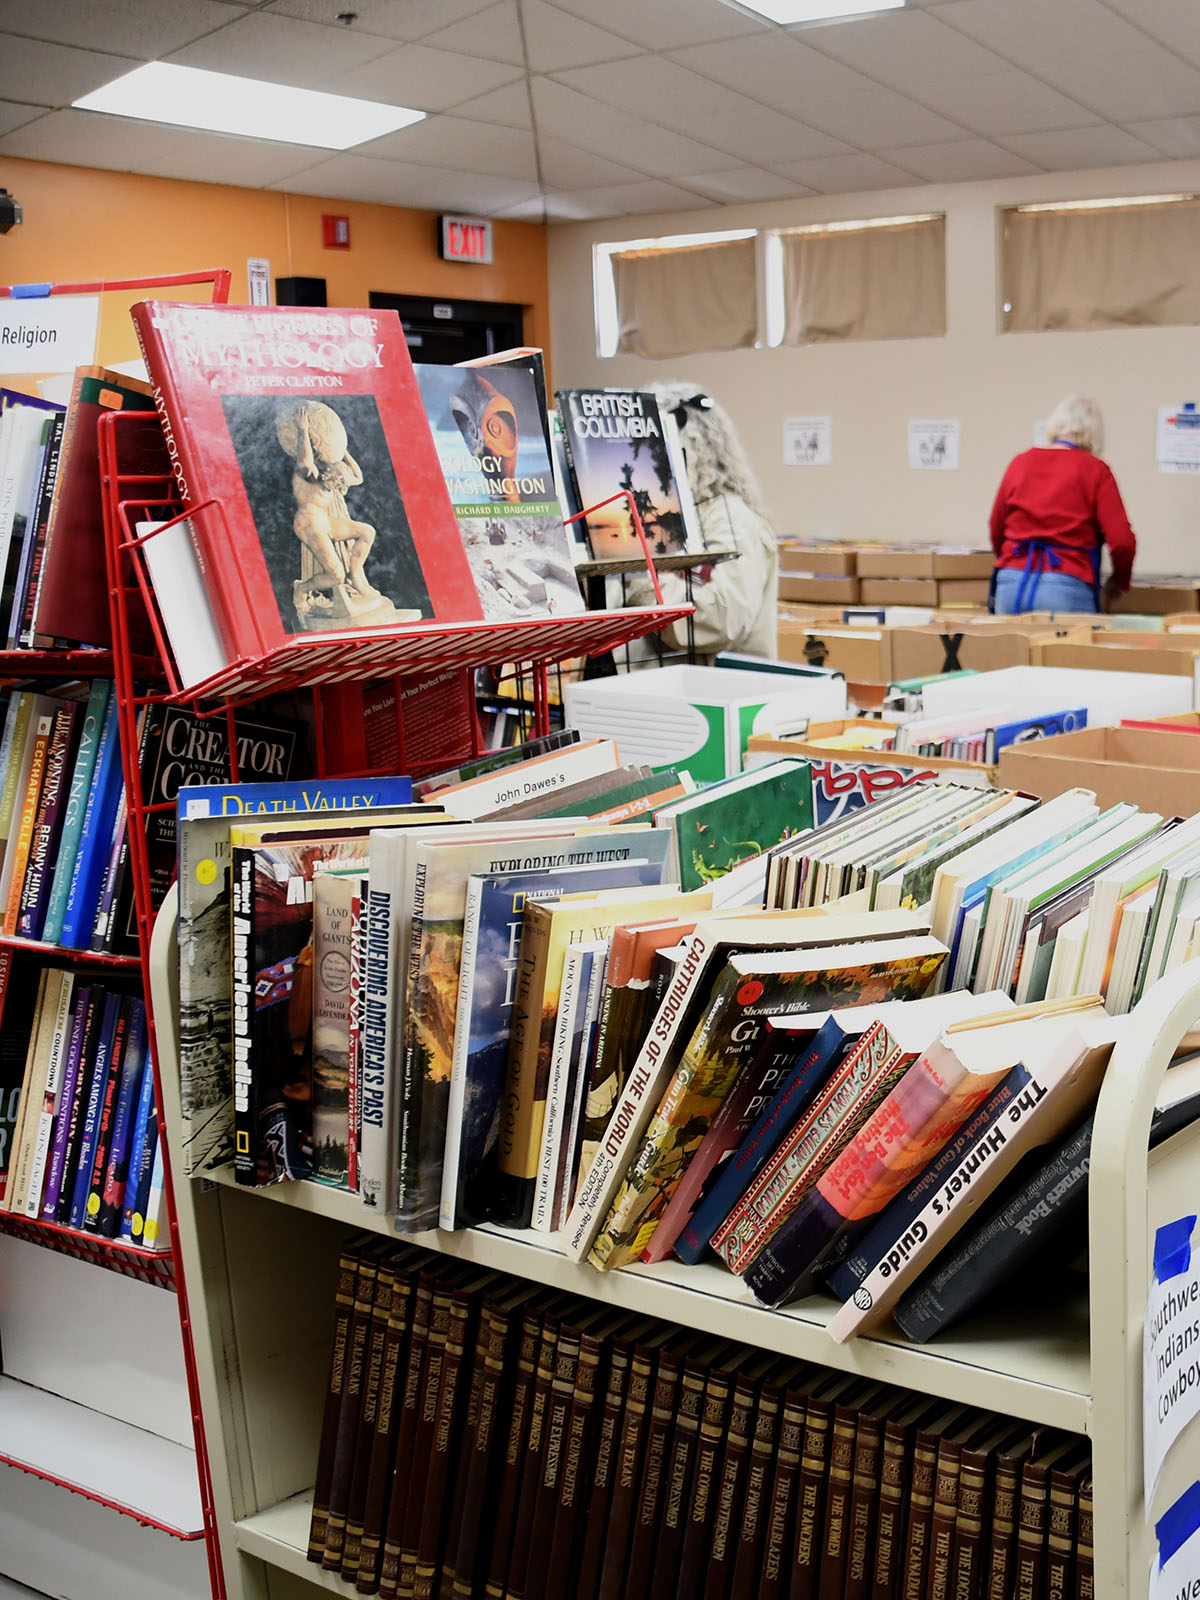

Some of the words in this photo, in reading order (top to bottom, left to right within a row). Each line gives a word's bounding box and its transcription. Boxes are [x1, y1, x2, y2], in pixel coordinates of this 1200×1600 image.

[447, 222, 486, 258] EXIT
[2, 325, 57, 348] Religion
[285, 375, 343, 388] CLAYTON
[581, 395, 643, 417] BRITISH
[53, 422, 64, 443] HAL
[153, 386, 191, 501] MYTHOLOGY
[574, 415, 659, 439] COLUMBIA
[45, 451, 59, 499] LINDSEY
[456, 505, 491, 515] RICHARD
[493, 506, 502, 515] D.
[503, 504, 551, 515] DAUGHERTY
[38, 522, 47, 541] THE
[32, 547, 45, 577] FINAL
[25, 583, 39, 620] BATTLE
[406, 686, 419, 698] Your
[419, 678, 439, 692] Perfect
[193, 720, 212, 729] THE
[25, 741, 46, 806] ECKHART
[65, 715, 97, 828] CALLINGS
[189, 763, 206, 772] AND
[210, 766, 226, 776] THE
[495, 788, 521, 804] John
[523, 772, 566, 795] Dawes's
[18, 807, 33, 851] TOLLE
[36, 824, 51, 873] BENNY
[569, 852, 595, 866] THE
[596, 848, 630, 863] WEST
[27, 872, 41, 909] HINN
[412, 863, 427, 925] EXPLORING
[326, 907, 348, 918] LAND
[330, 919, 342, 930] OF
[465, 894, 477, 939] RANGE
[322, 931, 351, 945] GIANTS
[368, 890, 391, 996] DISCOVERING
[410, 926, 422, 950] THE
[463, 940, 472, 957] OF
[234, 917, 252, 1036] American
[349, 912, 362, 1030] ARIZONA
[408, 953, 421, 984] WEST
[458, 958, 471, 1004] LIGHT
[518, 954, 537, 1000] THE
[654, 973, 665, 1000] ROOT
[55, 979, 70, 1030] JERUSALEM
[325, 1000, 345, 1010] DAVID
[561, 959, 576, 1016] MOUNTAIN
[649, 937, 706, 1042] CARTRIDGES
[72, 999, 85, 1040] BEYOND
[741, 1002, 785, 1017] Shooter's
[786, 1001, 812, 1013] Bible
[348, 1033, 355, 1048] IN
[364, 999, 387, 1085] AMERICA'S
[513, 1006, 529, 1052] AGE
[558, 1017, 570, 1053] BIKING
[47, 1032, 62, 1089] COUNTDOWN
[66, 1042, 77, 1079] GOOD
[93, 1042, 107, 1081] ANGELS
[643, 1041, 662, 1067] OF
[725, 1045, 743, 1054] Paul
[234, 1039, 253, 1113] Indian
[509, 1058, 522, 1084] OF
[554, 1056, 565, 1094] Southern
[629, 1070, 652, 1101] THE
[56, 1081, 72, 1144] INTENTIONS
[88, 1083, 98, 1118] AMONG
[347, 1087, 355, 1132] FUTURE
[363, 1087, 384, 1129] PAST
[987, 1085, 1012, 1110] Blue
[1008, 1079, 1049, 1124] The
[85, 1119, 93, 1133] US
[503, 1092, 520, 1156] GOLD
[547, 1095, 558, 1145] California's
[605, 1102, 638, 1159] WORLD
[854, 1097, 903, 1149] Hunting
[886, 1115, 912, 1141] The
[962, 1110, 991, 1143] Book
[78, 1141, 91, 1171] Rhodes
[543, 1146, 553, 1172] BEST
[597, 1151, 608, 1165] 4th
[865, 1136, 890, 1172] Ben
[935, 1150, 957, 1173] Gun
[953, 1139, 966, 1154] of
[44, 1151, 60, 1190] Bandow
[541, 1174, 549, 1188] 100
[589, 1158, 614, 1210] Completely
[827, 1148, 861, 1188] Book
[932, 1125, 1007, 1216] Hunter's
[578, 1165, 600, 1210] EDITION
[754, 1165, 796, 1216] MEXICO
[907, 1169, 938, 1204] Values
[537, 1189, 547, 1226] TRAILS
[744, 1203, 767, 1232] FRANZ
[571, 1208, 592, 1251] Revised
[765, 1249, 786, 1274] OUTDOOR
[879, 1220, 929, 1279] Guide
[758, 1263, 774, 1282] HARPER
[855, 1288, 872, 1310] NRA
[430, 1356, 442, 1375] THE
[1155, 1324, 1200, 1383] Indians
[424, 1376, 440, 1423] SOLDIERS
[534, 1392, 546, 1412] THE
[554, 1405, 566, 1426] THE
[528, 1413, 543, 1453] MINERS
[573, 1416, 585, 1437] THE
[602, 1418, 614, 1439] THE
[627, 1426, 639, 1446] THE
[544, 1426, 564, 1489] EXPRESSMEN
[595, 1439, 612, 1489] SOLDIERS
[621, 1448, 636, 1488] TEXANS
[677, 1442, 689, 1463] THE
[702, 1450, 714, 1471] THE
[726, 1459, 739, 1480] THE
[561, 1437, 582, 1508] GUNFIGHTERS
[752, 1466, 764, 1488] THE
[777, 1477, 791, 1498] THE
[667, 1463, 687, 1529] EXPRESSMEN
[693, 1473, 711, 1523] COWBOYS
[804, 1485, 817, 1506] THE
[832, 1494, 845, 1516] THE
[713, 1481, 736, 1561] FRONTIERSMEN
[743, 1489, 762, 1543] PIONEERS
[856, 1503, 869, 1526] THE
[880, 1513, 893, 1536] THE
[766, 1500, 788, 1581] TRAILBLAZERS
[797, 1506, 815, 1567] RANCHERS
[827, 1519, 843, 1558] WOMEN
[851, 1528, 867, 1581] COWBOYS
[876, 1538, 891, 1586] INDIANS
